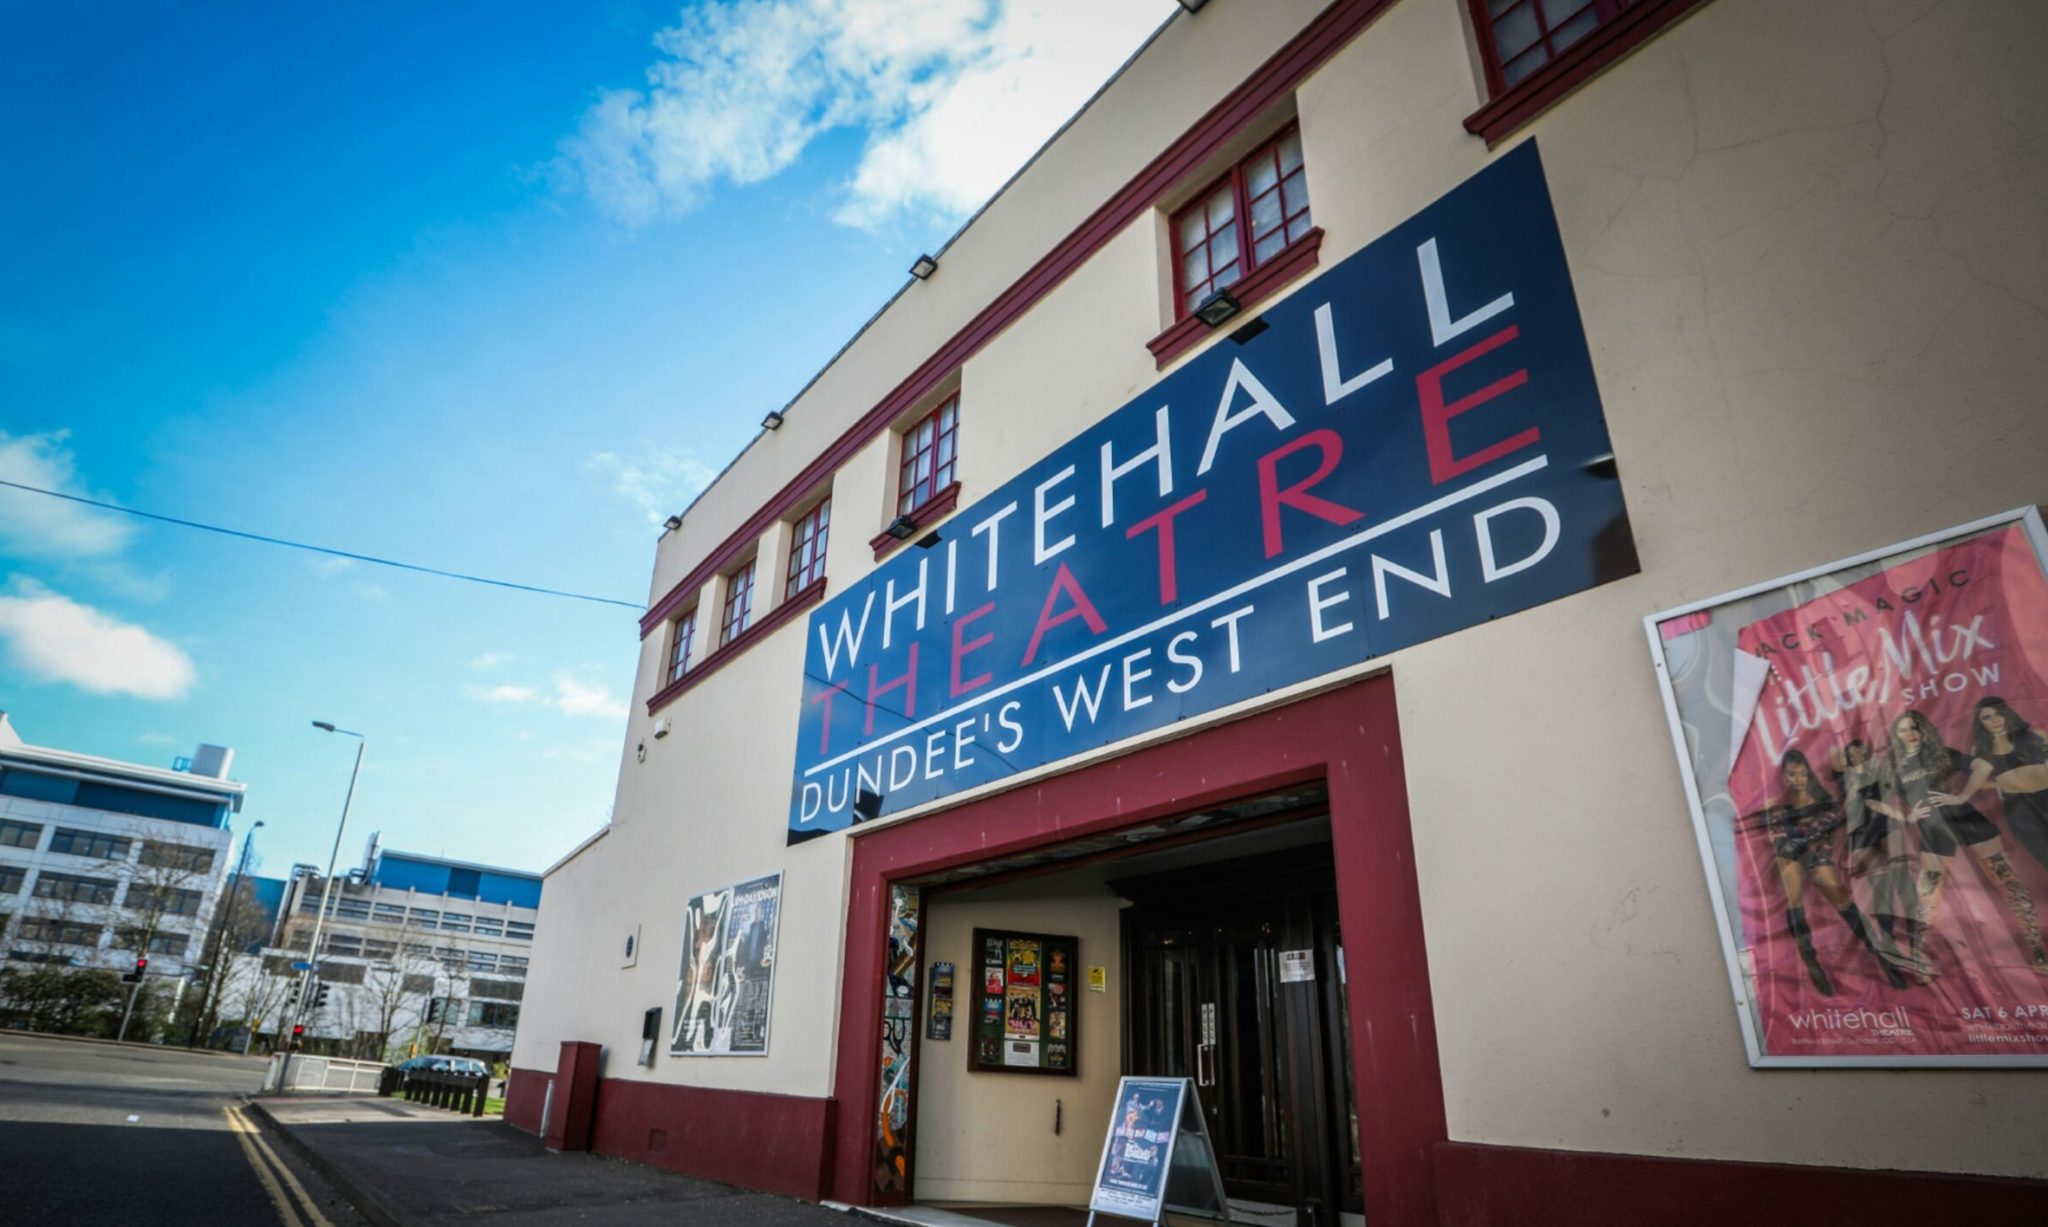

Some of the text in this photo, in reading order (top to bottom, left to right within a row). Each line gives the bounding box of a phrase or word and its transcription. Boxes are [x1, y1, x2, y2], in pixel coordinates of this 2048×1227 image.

[819, 237, 1515, 680] WHITEHALL
[812, 324, 1541, 755] THEATRE
[1843, 570, 1969, 627] MAGIC
[800, 496, 1561, 824] DUNDEE'S WEST END
[1756, 610, 1995, 766] Little Mix
[1901, 662, 2000, 706] SHOW
[1788, 1005, 1911, 1031] whitehall
[1961, 1007, 1991, 1020] SAT
[1998, 1006, 2008, 1019] 6
